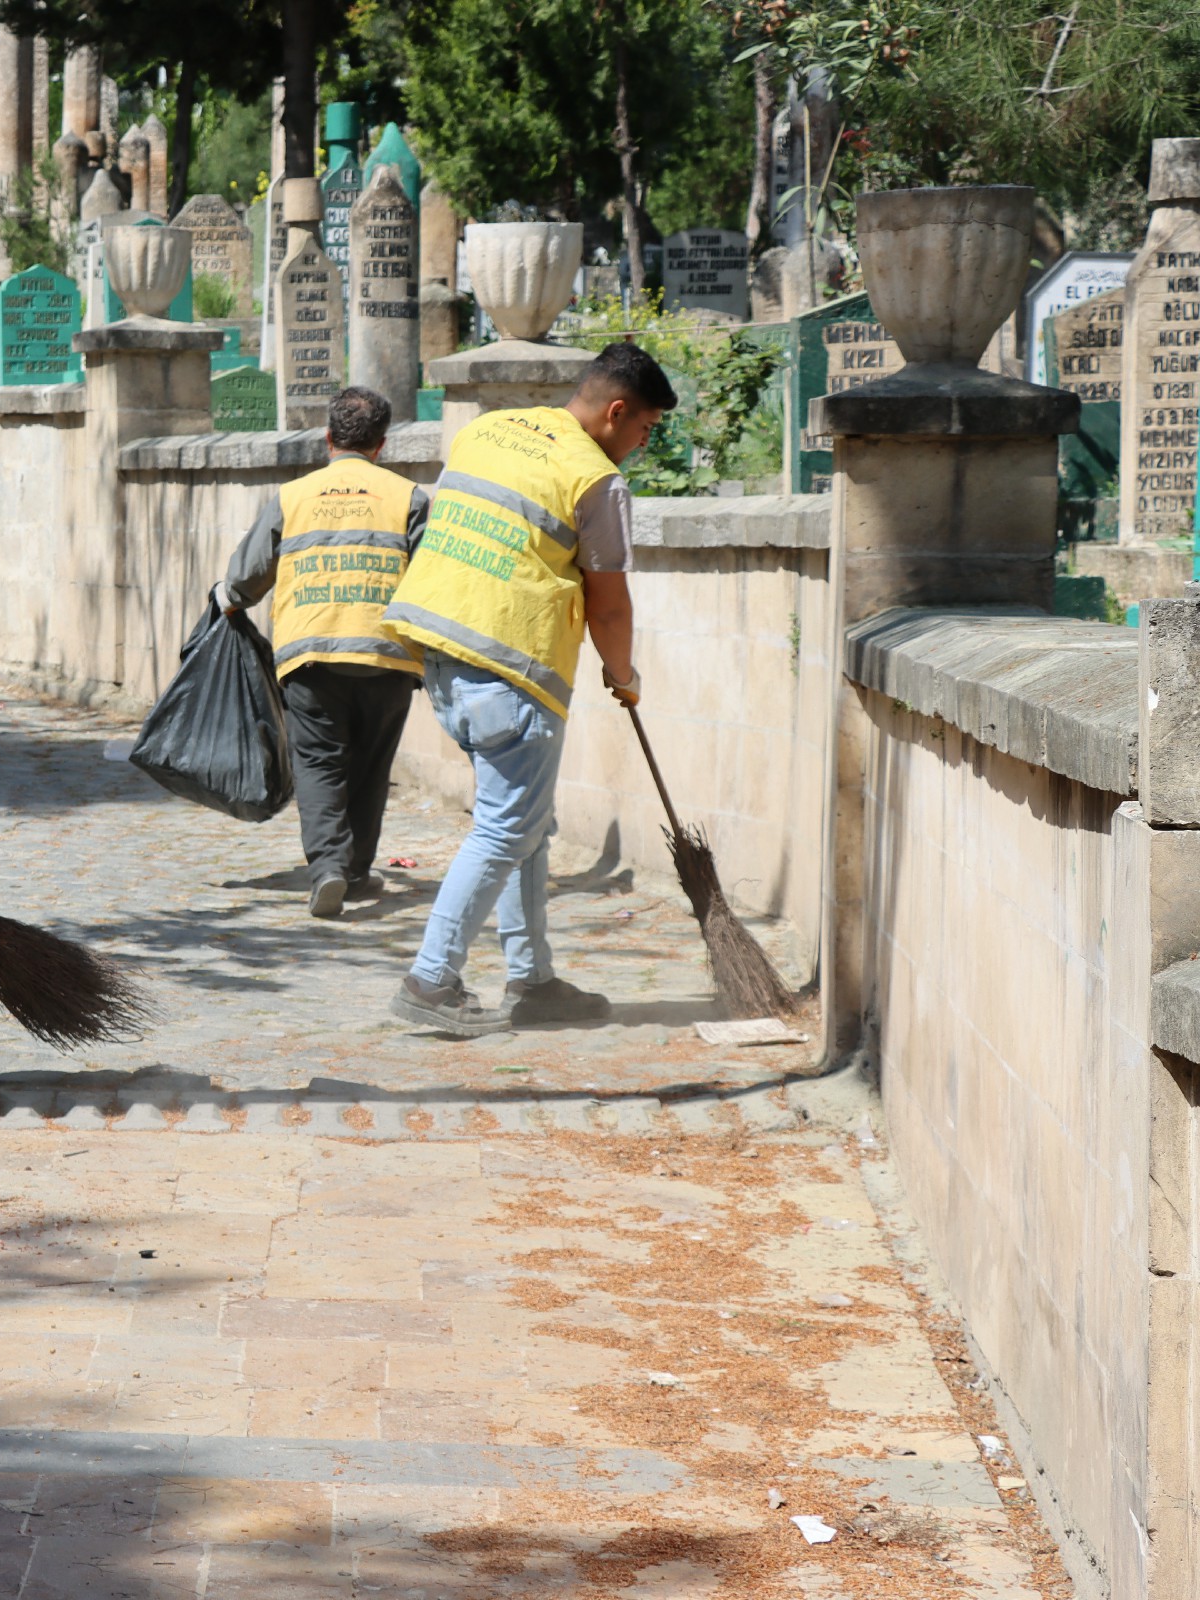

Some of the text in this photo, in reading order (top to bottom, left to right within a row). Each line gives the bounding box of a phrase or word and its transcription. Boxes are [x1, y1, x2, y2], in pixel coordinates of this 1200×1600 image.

[1065, 286, 1080, 299] EL
[843, 348, 886, 370] KIZI
[294, 552, 401, 577] PARK VE BAHÇELER
